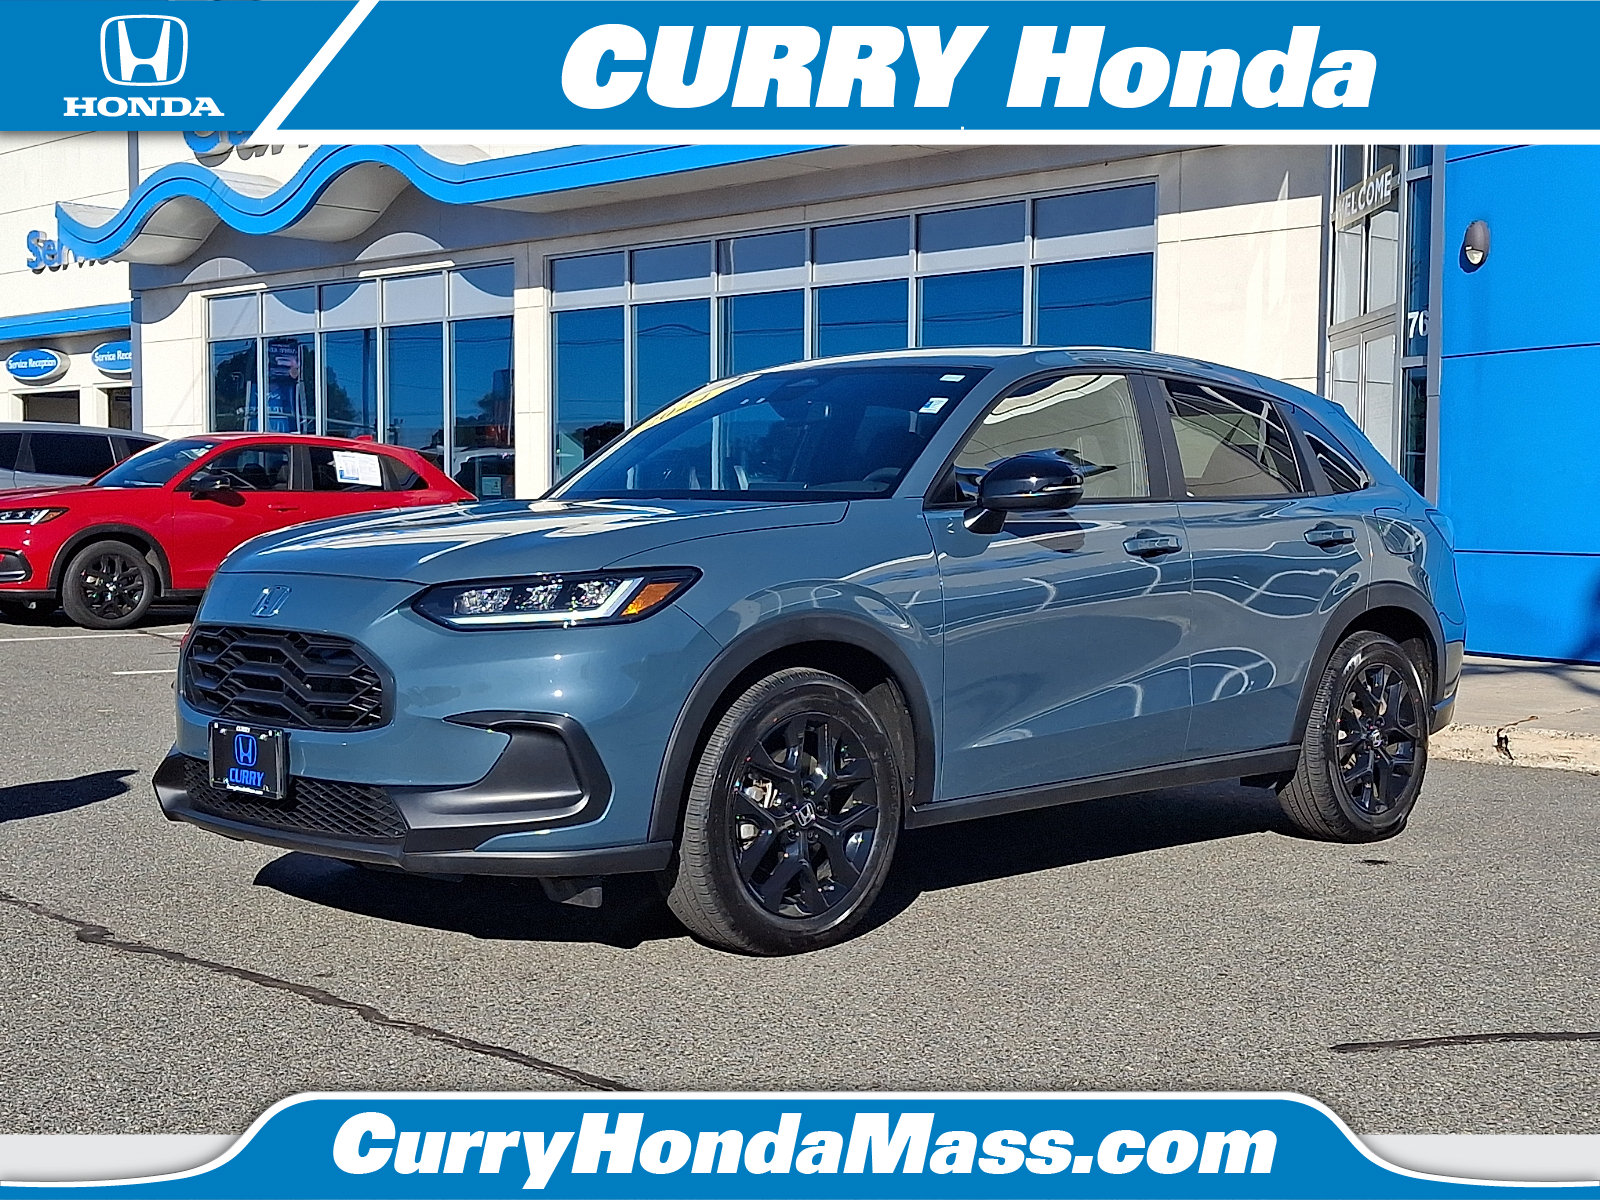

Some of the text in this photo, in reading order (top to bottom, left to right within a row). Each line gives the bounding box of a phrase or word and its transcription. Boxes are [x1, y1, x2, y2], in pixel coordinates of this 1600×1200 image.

[1338, 170, 1393, 218] WELCOME
[94, 351, 116, 362] Service
[8, 359, 28, 370] Service
[229, 767, 264, 786] CURRY
